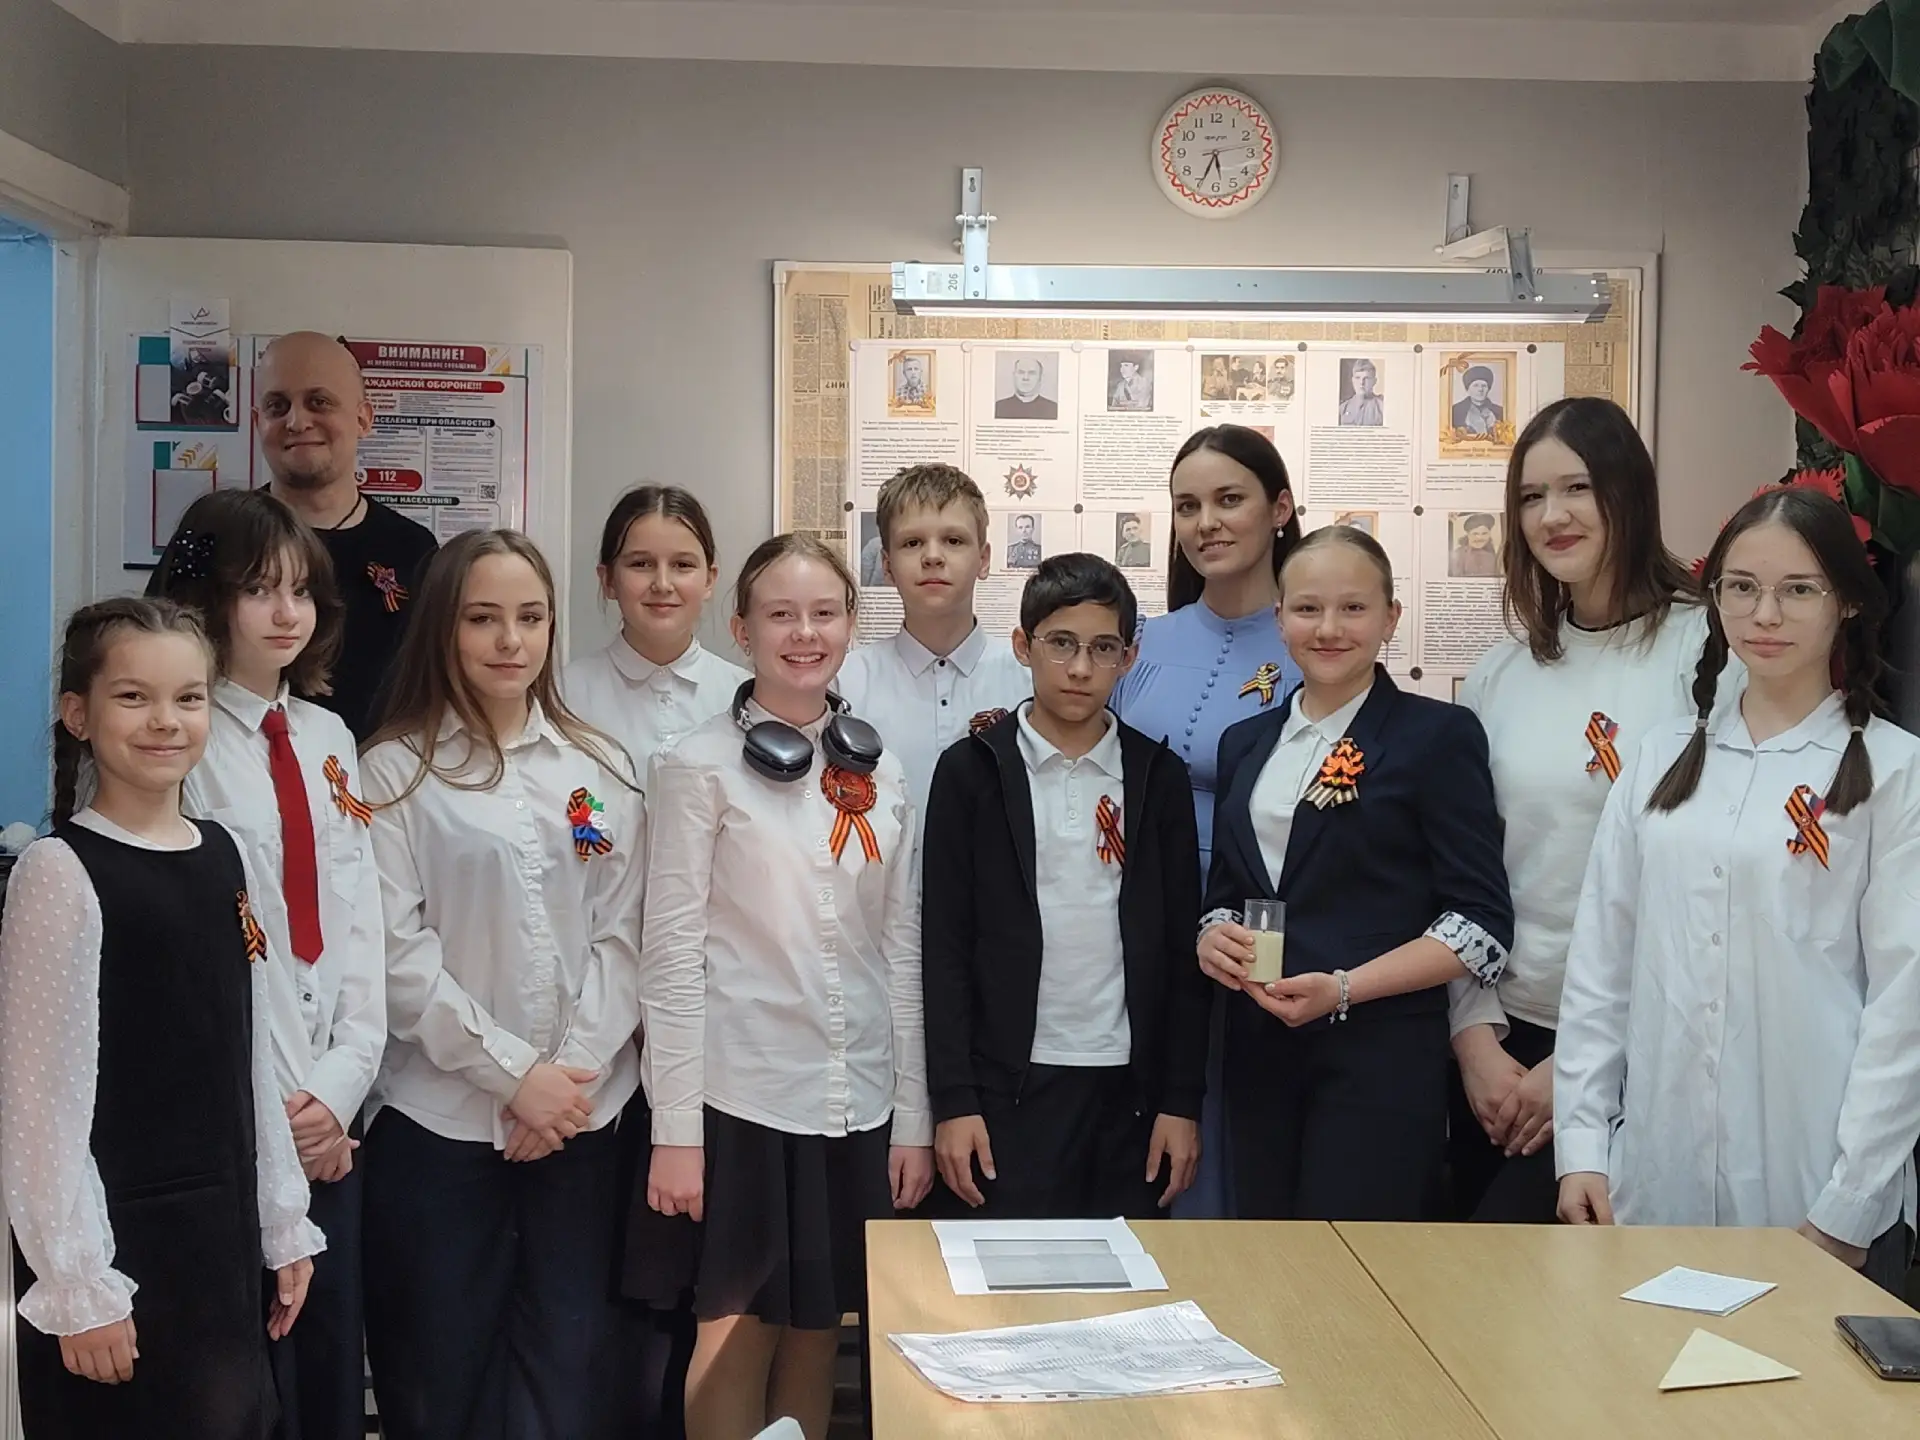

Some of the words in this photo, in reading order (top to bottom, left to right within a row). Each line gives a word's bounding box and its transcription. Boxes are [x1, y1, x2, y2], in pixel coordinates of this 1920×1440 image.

[1194, 118, 1204, 128] 11
[1210, 113, 1223, 123] 12
[1182, 130, 1195, 141] 10
[1241, 130, 1251, 141] 2
[1177, 148, 1187, 158] 9
[1246, 148, 1255, 158] 3
[1182, 165, 1192, 176] 8
[1240, 166, 1249, 175] 4
[1195, 178, 1204, 188] 7
[1211, 182, 1220, 192] 6
[1229, 178, 1238, 188] 5
[948, 273, 959, 291] 206
[378, 345, 465, 360] ВНИМАНИЕ!
[364, 378, 425, 388] АЖДАНСКОЙ
[427, 380, 482, 390] ОБОРОНЕ!!!
[375, 416, 418, 425] АСЕЛЕНИЯ
[439, 419, 491, 427] ОПАСНОСТИ!
[378, 470, 397, 482] 112
[372, 495, 398, 503] ЩИТЫ
[400, 496, 452, 504] НАСЕЛЕНИЯ!
